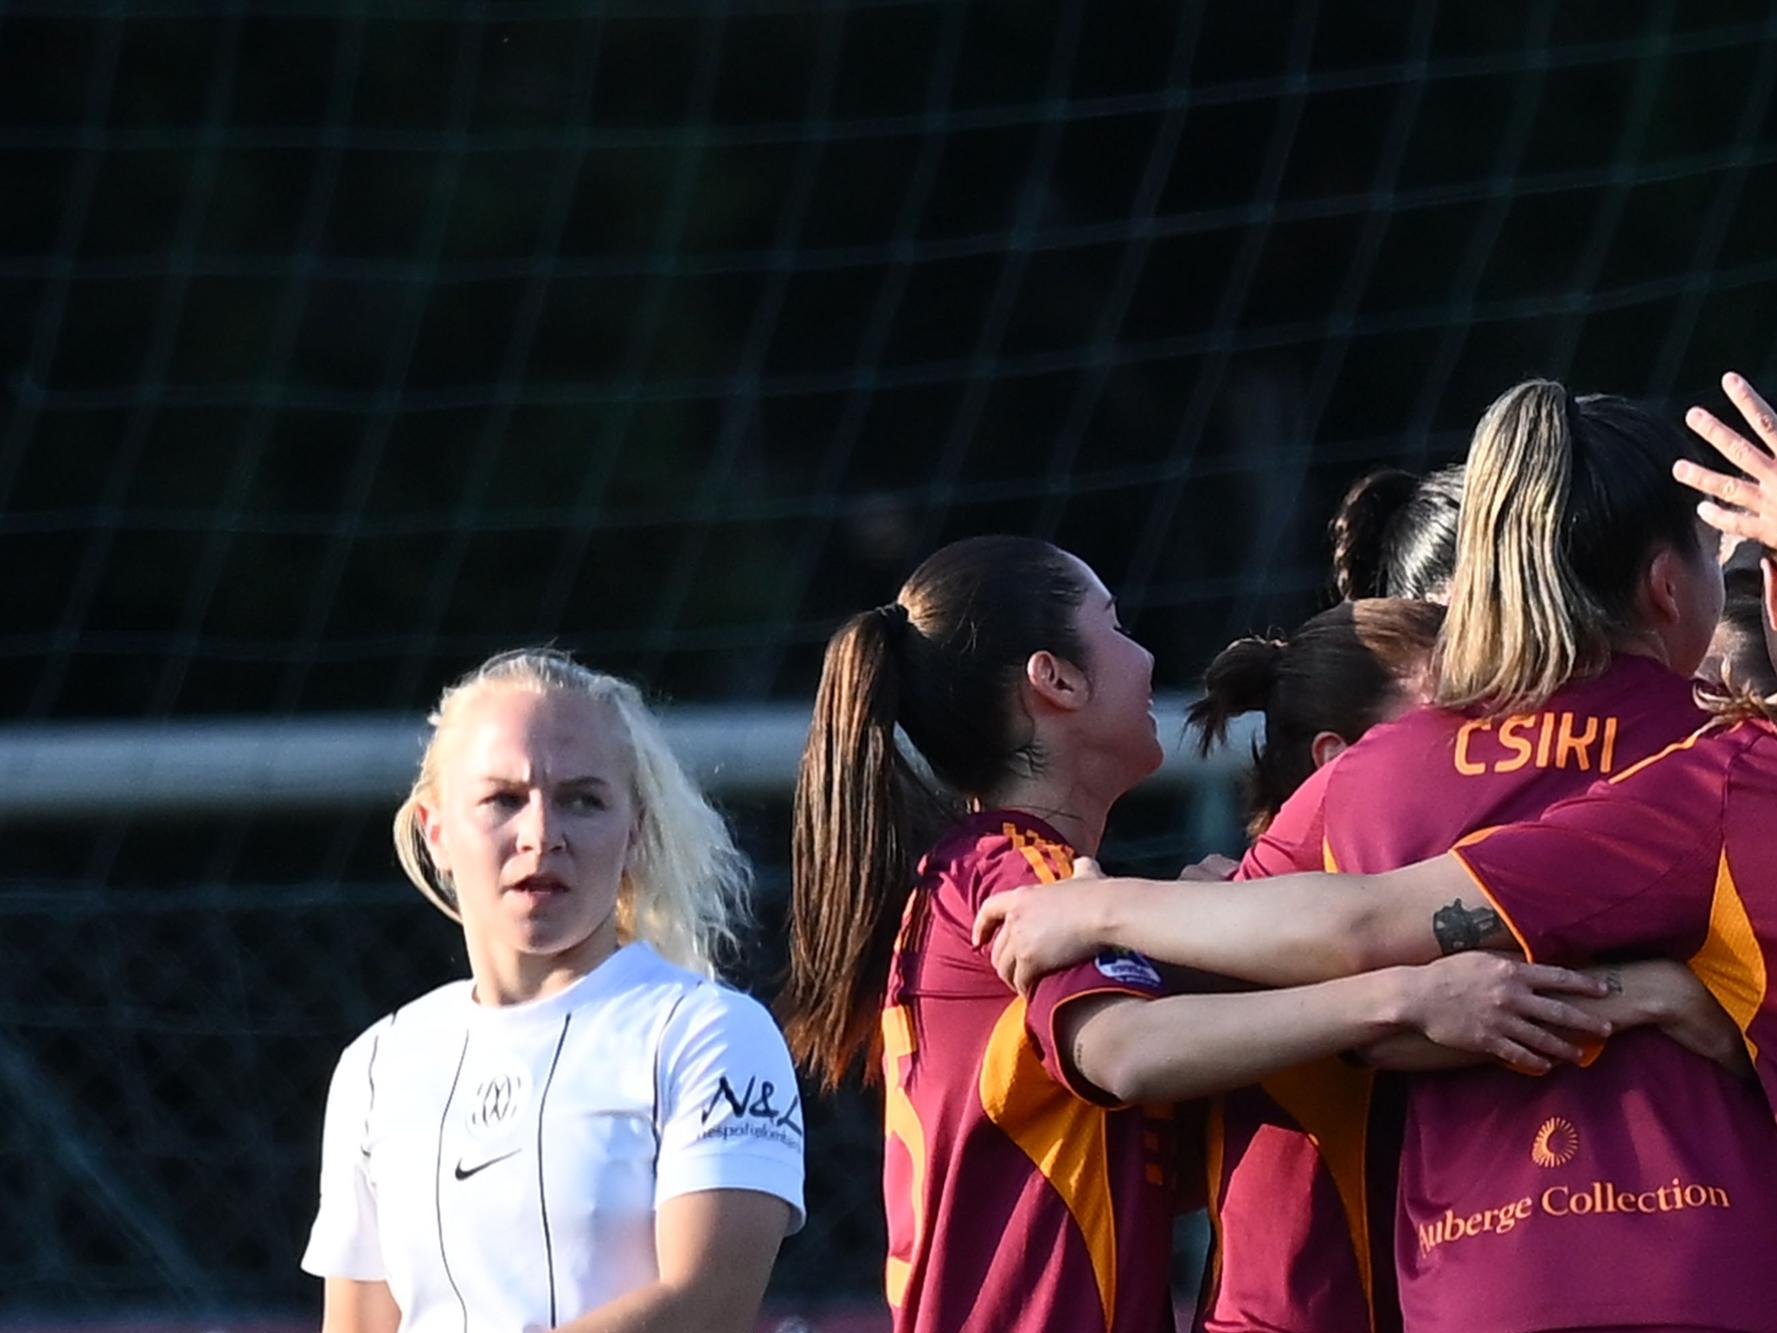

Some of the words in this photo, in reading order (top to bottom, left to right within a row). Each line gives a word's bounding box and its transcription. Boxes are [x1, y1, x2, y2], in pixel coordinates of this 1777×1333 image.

[1454, 711, 1618, 777] CSIKI
[1417, 1196, 1533, 1260] Auberge
[1541, 1177, 1731, 1217] Collection
